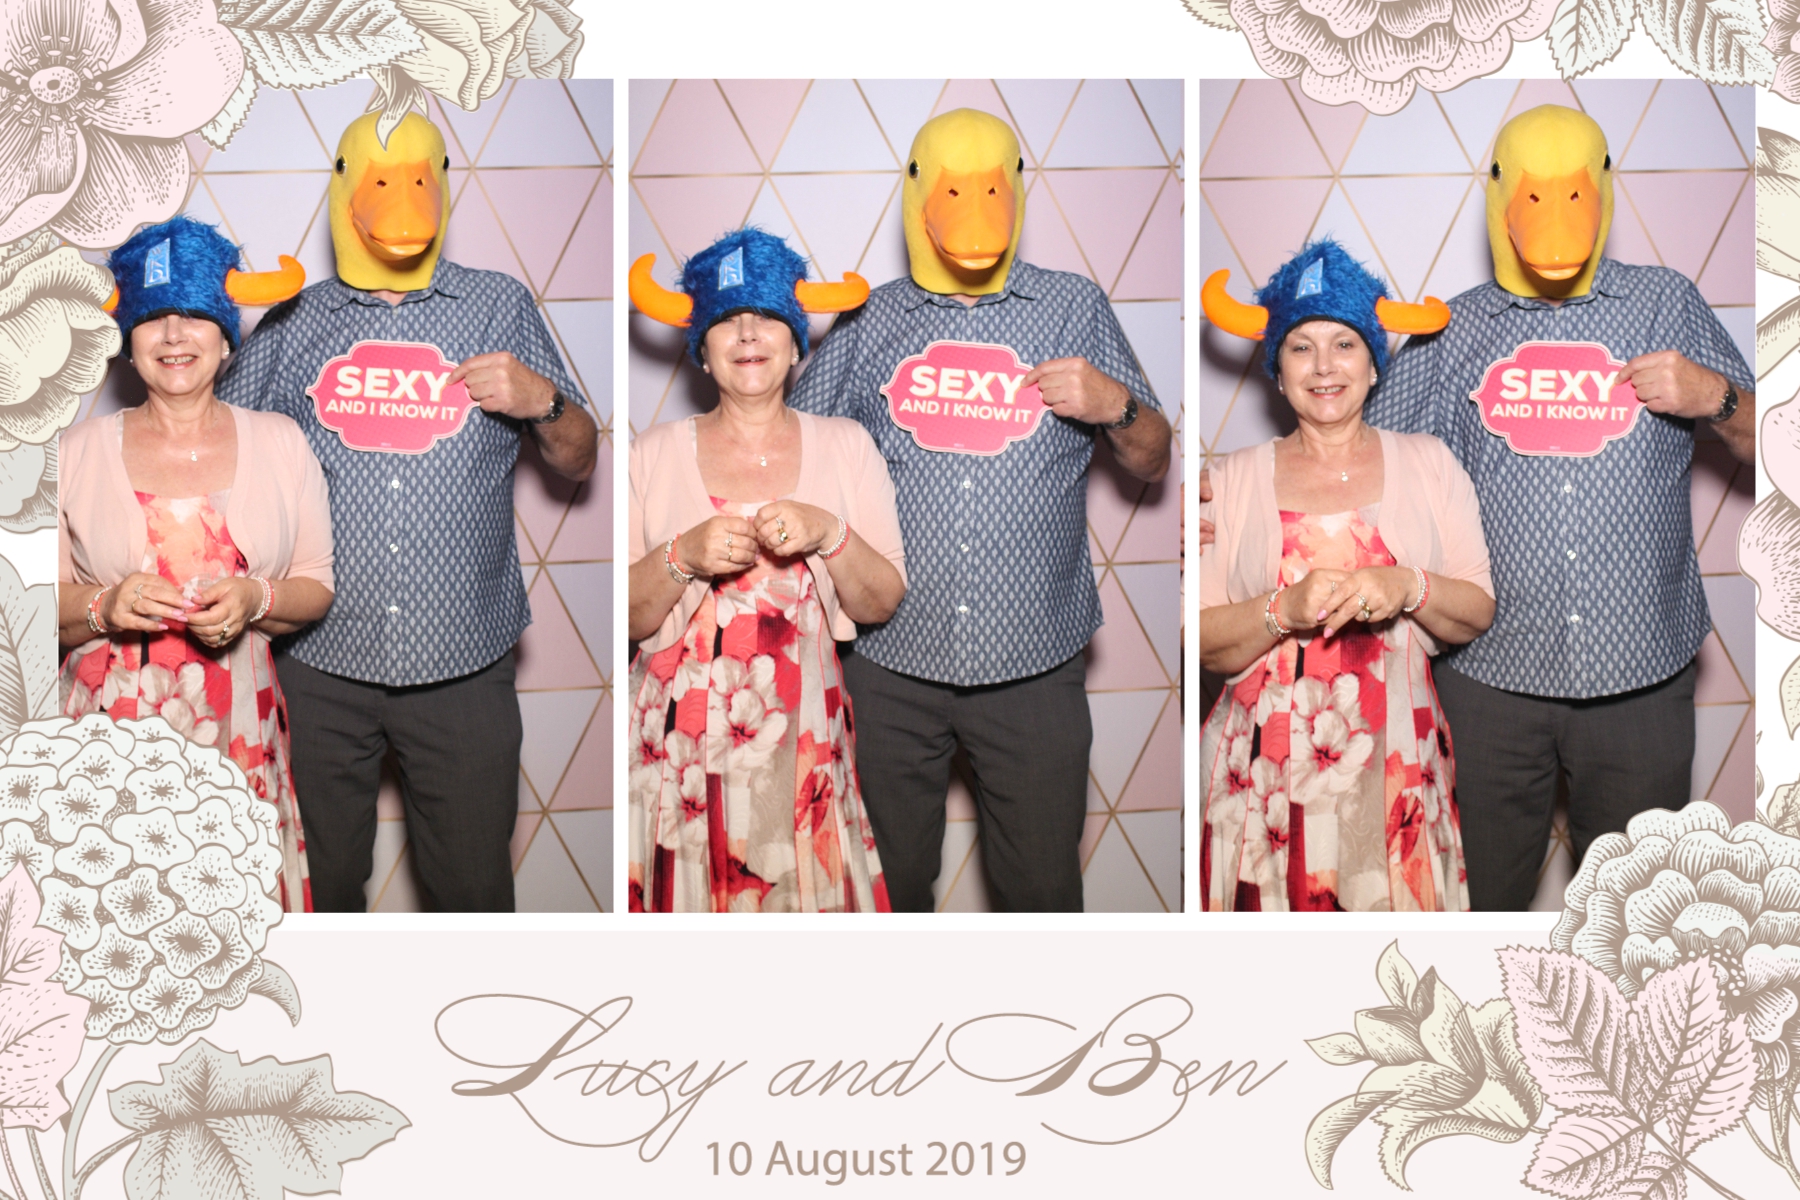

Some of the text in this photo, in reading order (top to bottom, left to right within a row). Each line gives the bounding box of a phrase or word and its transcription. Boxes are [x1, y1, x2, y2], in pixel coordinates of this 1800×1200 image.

[334, 365, 452, 403] SEXY
[909, 365, 1026, 405] SEXY
[1499, 368, 1619, 403] SEXY
[325, 399, 459, 421] AND I KNOW IT
[898, 398, 1032, 424] AND I KNOW IT
[1490, 403, 1628, 421] AND I KNOW IT
